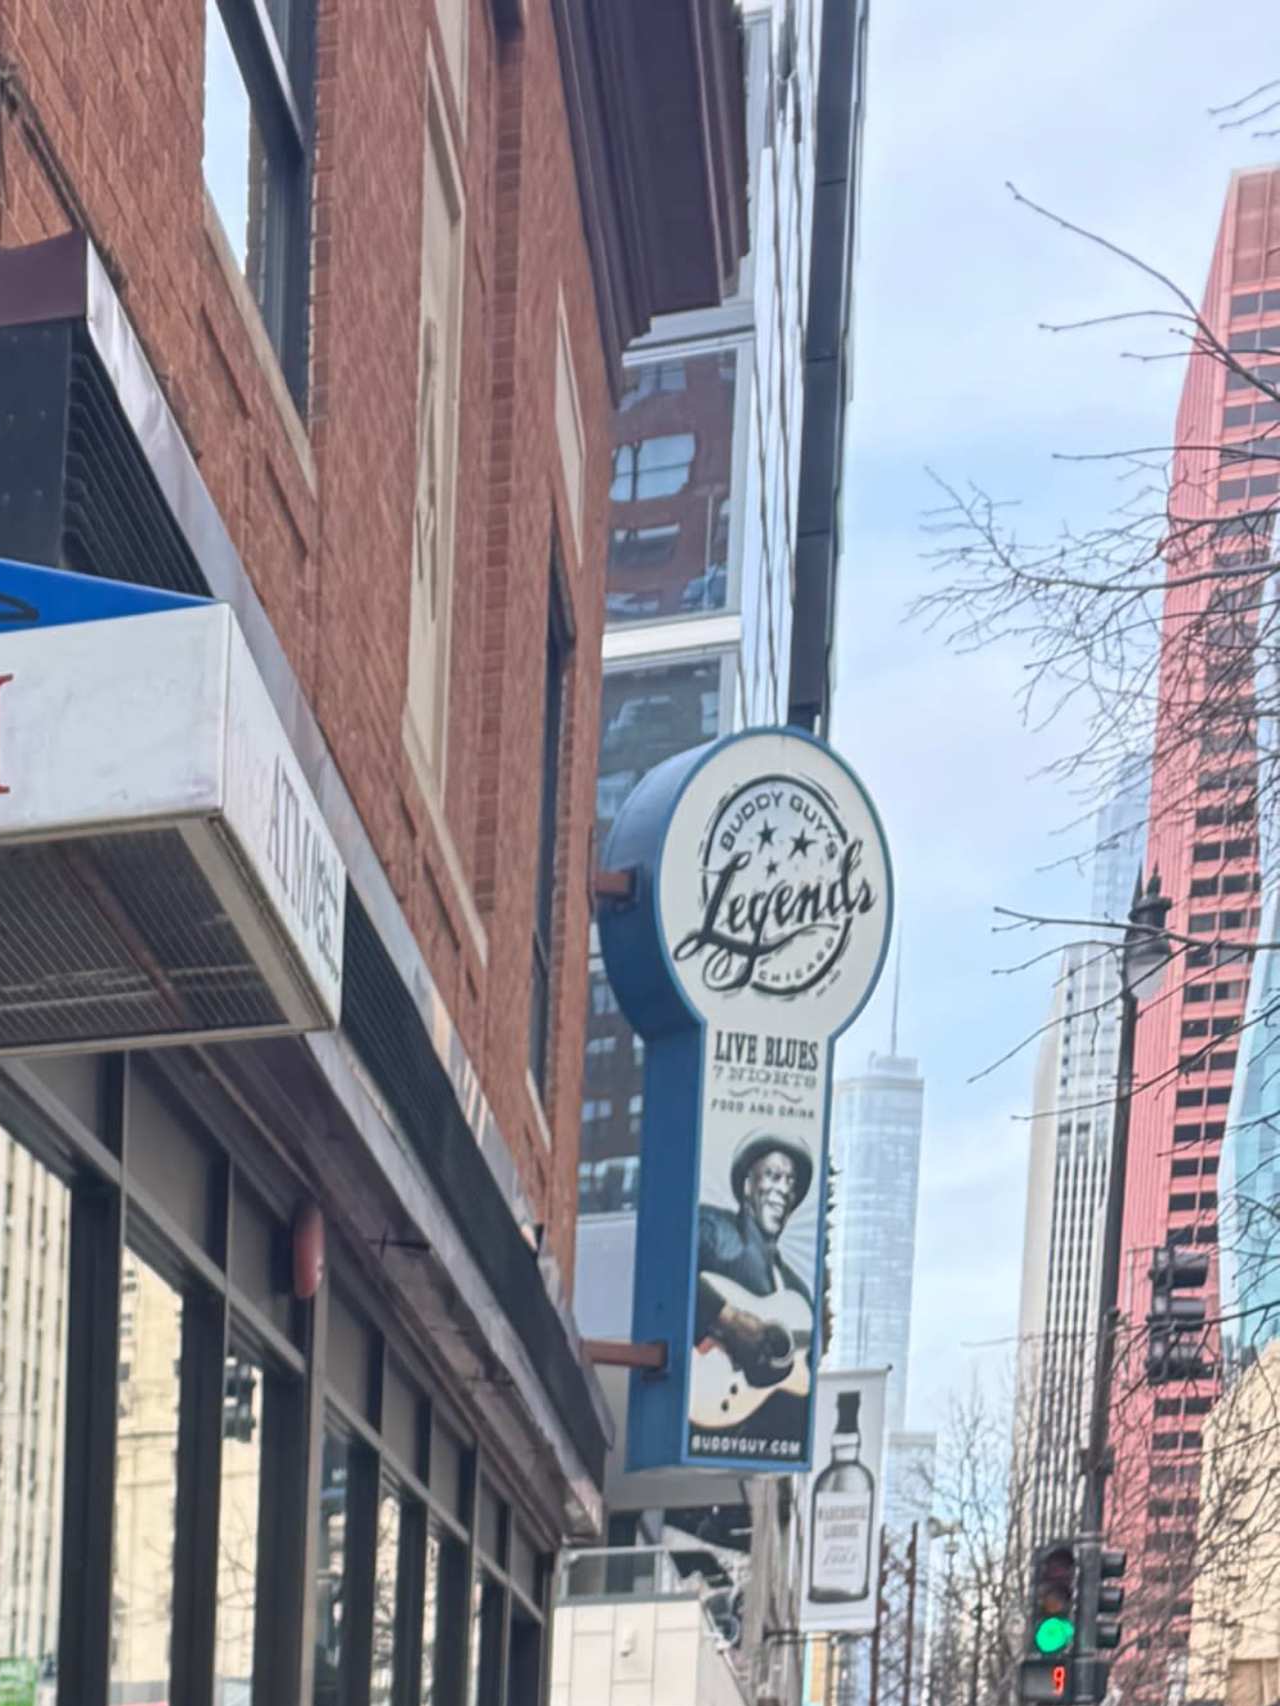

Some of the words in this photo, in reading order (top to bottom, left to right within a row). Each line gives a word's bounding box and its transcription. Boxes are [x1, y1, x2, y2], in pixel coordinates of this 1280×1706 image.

[720, 791, 784, 851] BUDDY
[790, 794, 839, 860] GUY'S
[673, 837, 876, 992] Legends
[758, 936, 835, 982] CHICAGO
[714, 1030, 758, 1065] LIVE
[764, 1036, 818, 1071] BLUES
[729, 1066, 817, 1088] NIGHTS
[712, 1099, 745, 1113] FOOD
[750, 1102, 774, 1117] AND
[691, 1434, 801, 1455] BUDDYGUY.COM
[1053, 1666, 1065, 1696] 9
